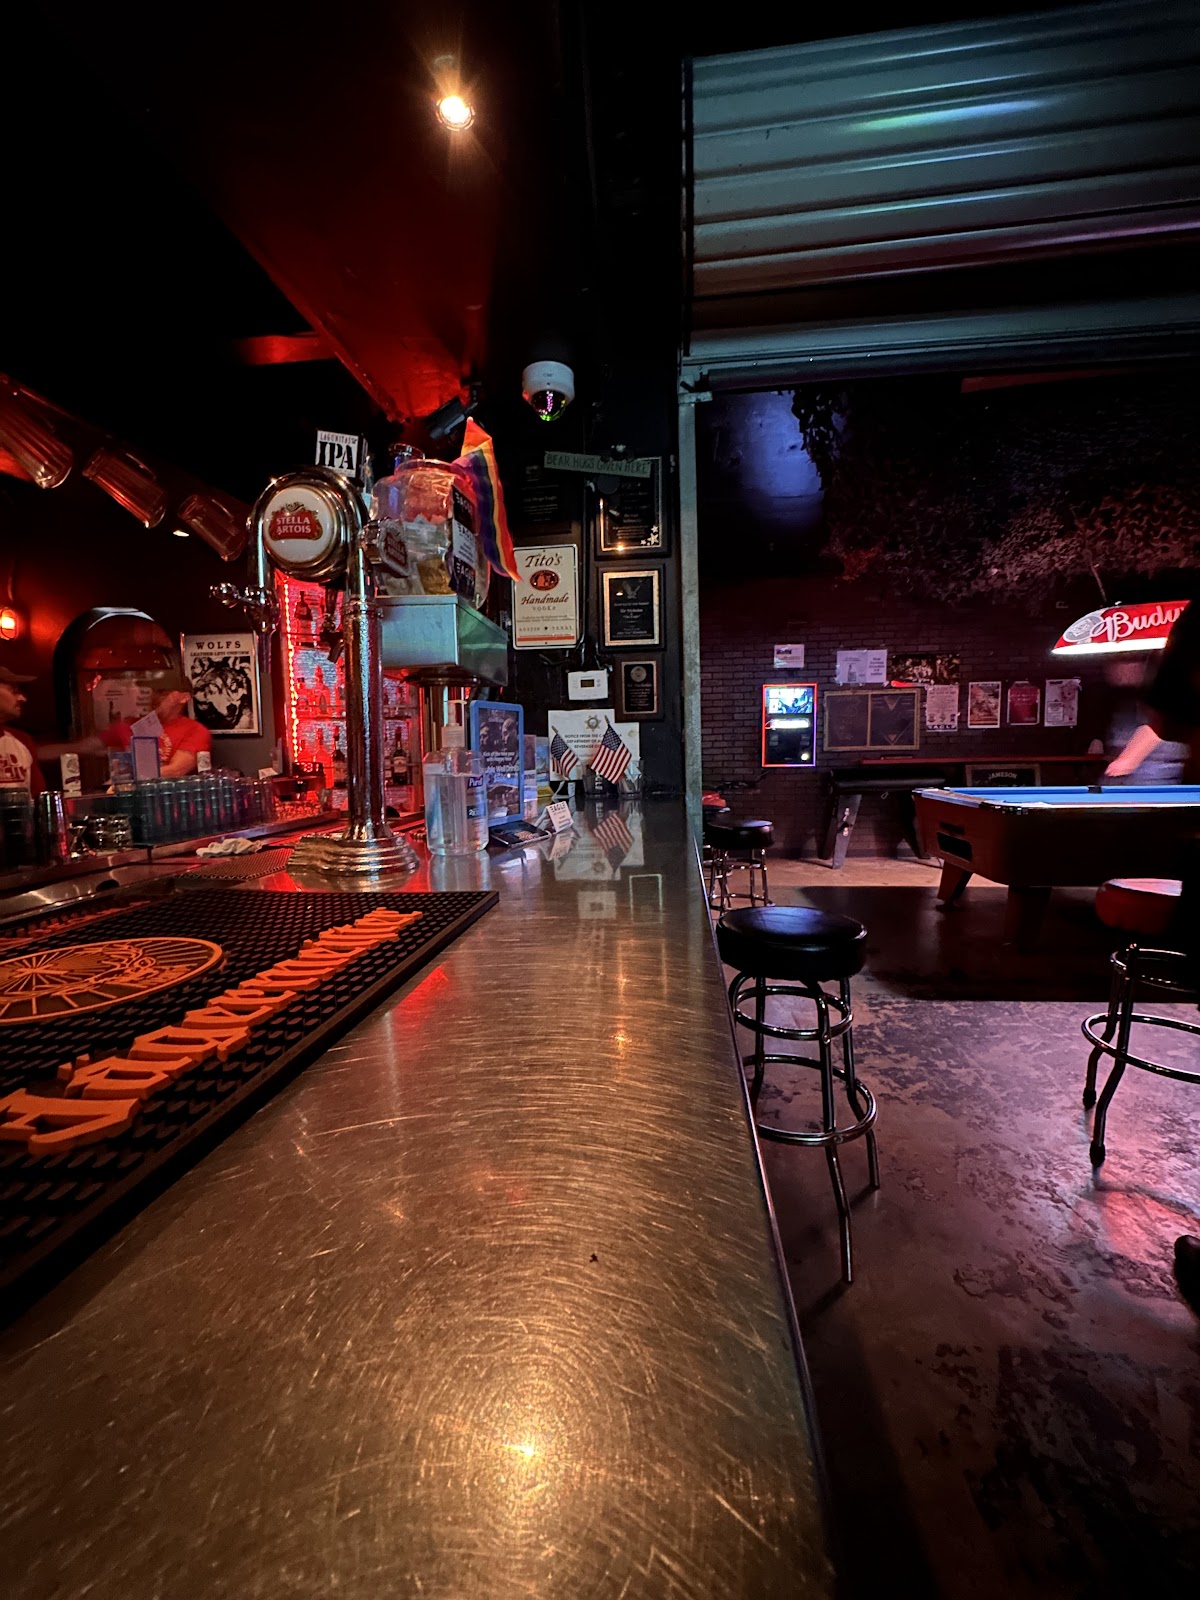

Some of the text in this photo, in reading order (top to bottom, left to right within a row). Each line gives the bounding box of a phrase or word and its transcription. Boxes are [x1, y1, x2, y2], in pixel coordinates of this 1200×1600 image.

[318, 441, 354, 470] IPA
[546, 453, 648, 474] BEAR HUGS GIVEN HERE
[276, 516, 311, 525] STELLA
[276, 525, 312, 535] ARTOIS
[525, 553, 563, 568] Tito's
[521, 592, 570, 605] Handmade
[196, 641, 241, 650] WOLFS
[988, 771, 1017, 780] JAMESON
